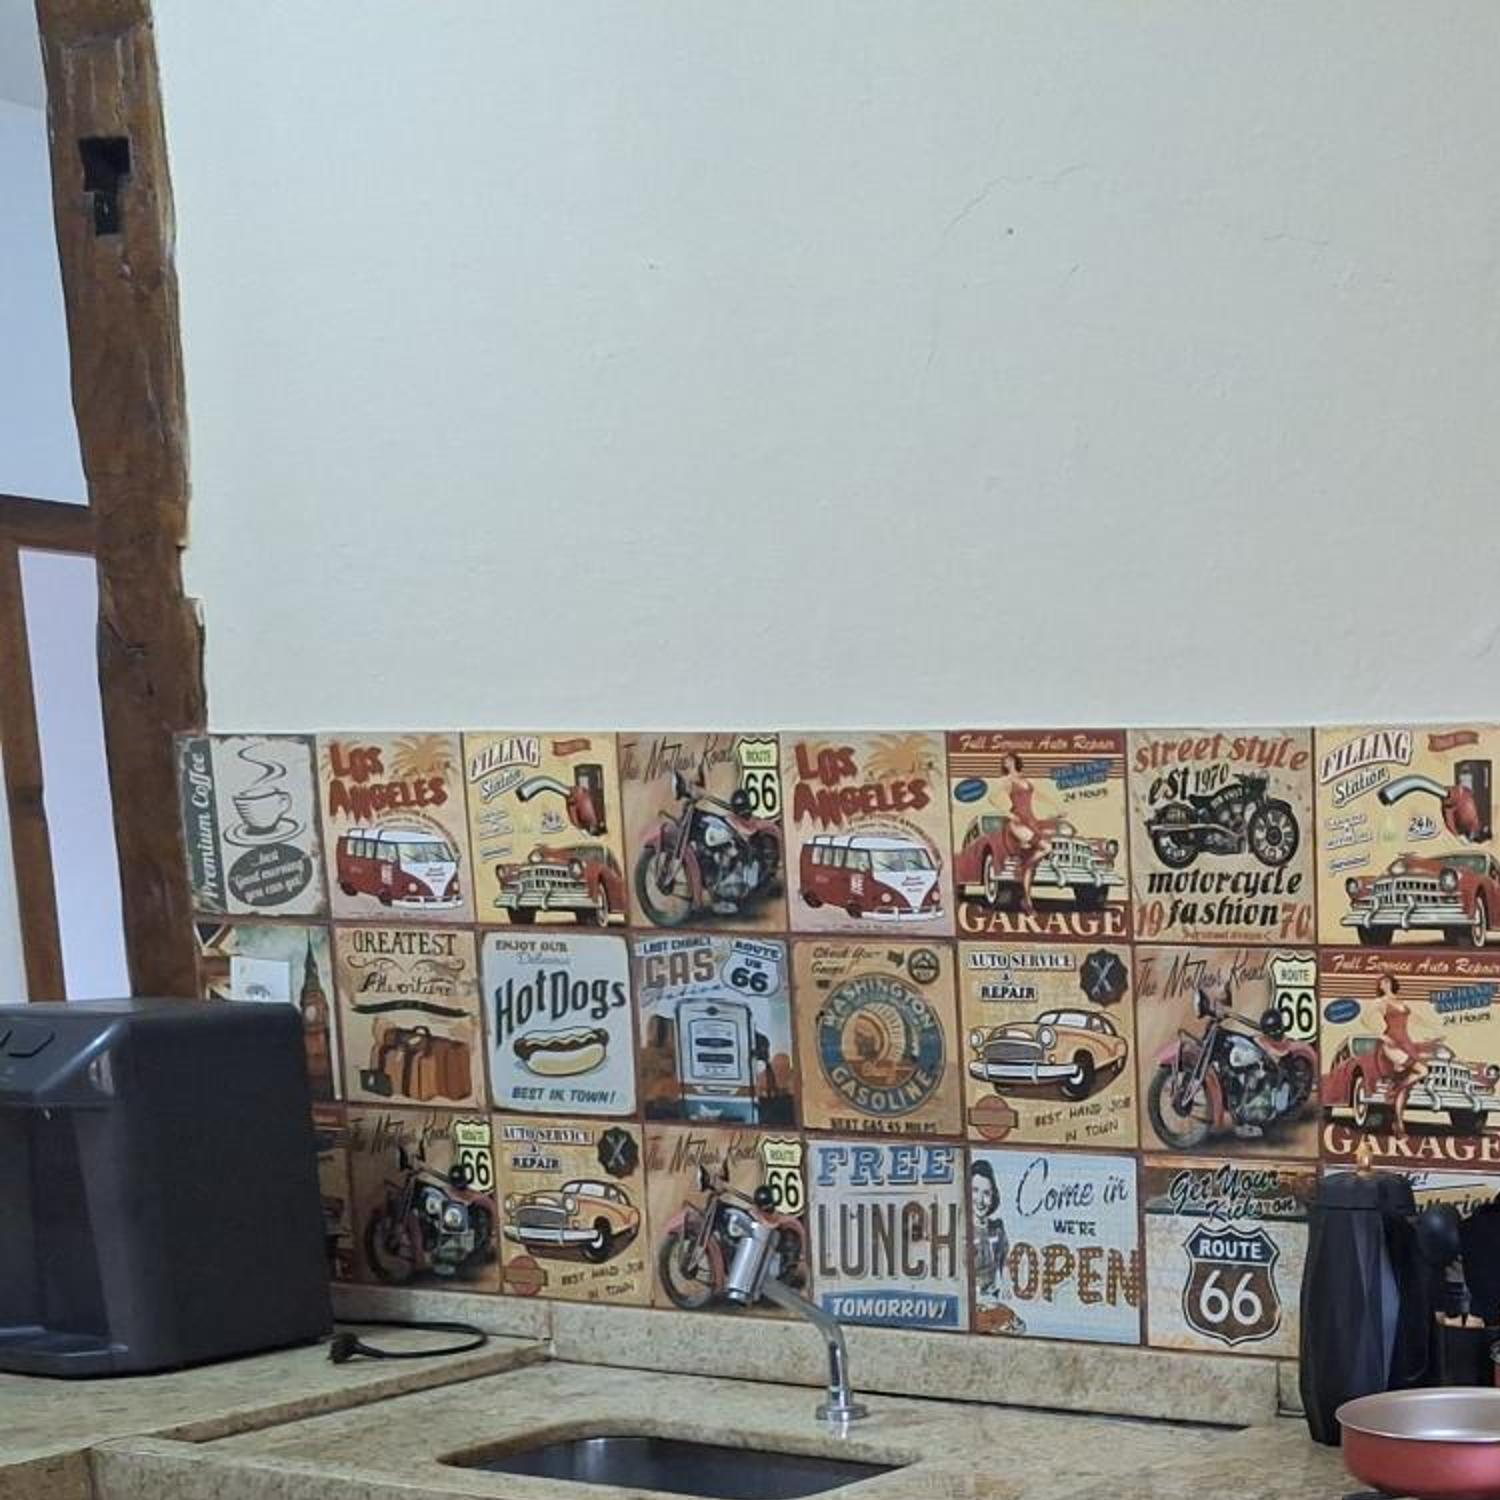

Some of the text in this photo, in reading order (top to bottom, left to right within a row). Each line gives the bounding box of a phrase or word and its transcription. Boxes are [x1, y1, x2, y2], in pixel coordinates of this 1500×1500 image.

[328, 742, 384, 784] LOS
[470, 737, 540, 777] FILLING
[794, 740, 857, 785] LOS
[1134, 733, 1309, 773] street style
[1321, 731, 1411, 780] FILLING
[191, 751, 215, 808] Coffee
[328, 777, 448, 820] ANGELES
[746, 773, 777, 812] 66
[1195, 765, 1230, 794] 1970
[1335, 767, 1388, 804] Station
[793, 778, 931, 825] ANGELES
[1147, 867, 1302, 901] motorcycle
[957, 902, 1128, 936] GARAGE
[1166, 897, 1279, 929] fashion
[352, 931, 457, 957] GREATEST
[967, 953, 1075, 968] AUTO SERVICE
[643, 948, 716, 989] GAS
[730, 968, 770, 994] 66
[1280, 968, 1310, 982] ROUTE
[1416, 957, 1449, 975] Auto
[823, 977, 936, 1031] WASHINGTON
[981, 986, 1035, 999] REPAIR
[1277, 992, 1314, 1034] 66
[512, 1086, 545, 1100] BEST
[569, 1090, 617, 1104] TOWN!
[831, 1066, 933, 1111] GASOLINE
[1085, 1121, 1120, 1137] TOWN
[461, 1150, 490, 1187] 66
[511, 1157, 560, 1170] REPAIR
[816, 1146, 955, 1186] FREE
[768, 1171, 800, 1208] 66
[1016, 1157, 1128, 1217] Come in
[1168, 1163, 1281, 1214] Get Your
[1053, 1219, 1097, 1238] WE'RE
[1205, 1196, 1296, 1223] Kicks on
[817, 1200, 957, 1280] LUNCH
[1199, 1238, 1262, 1260] ROUTE
[1007, 1241, 1140, 1308] OPEN
[1200, 1269, 1264, 1326] 66
